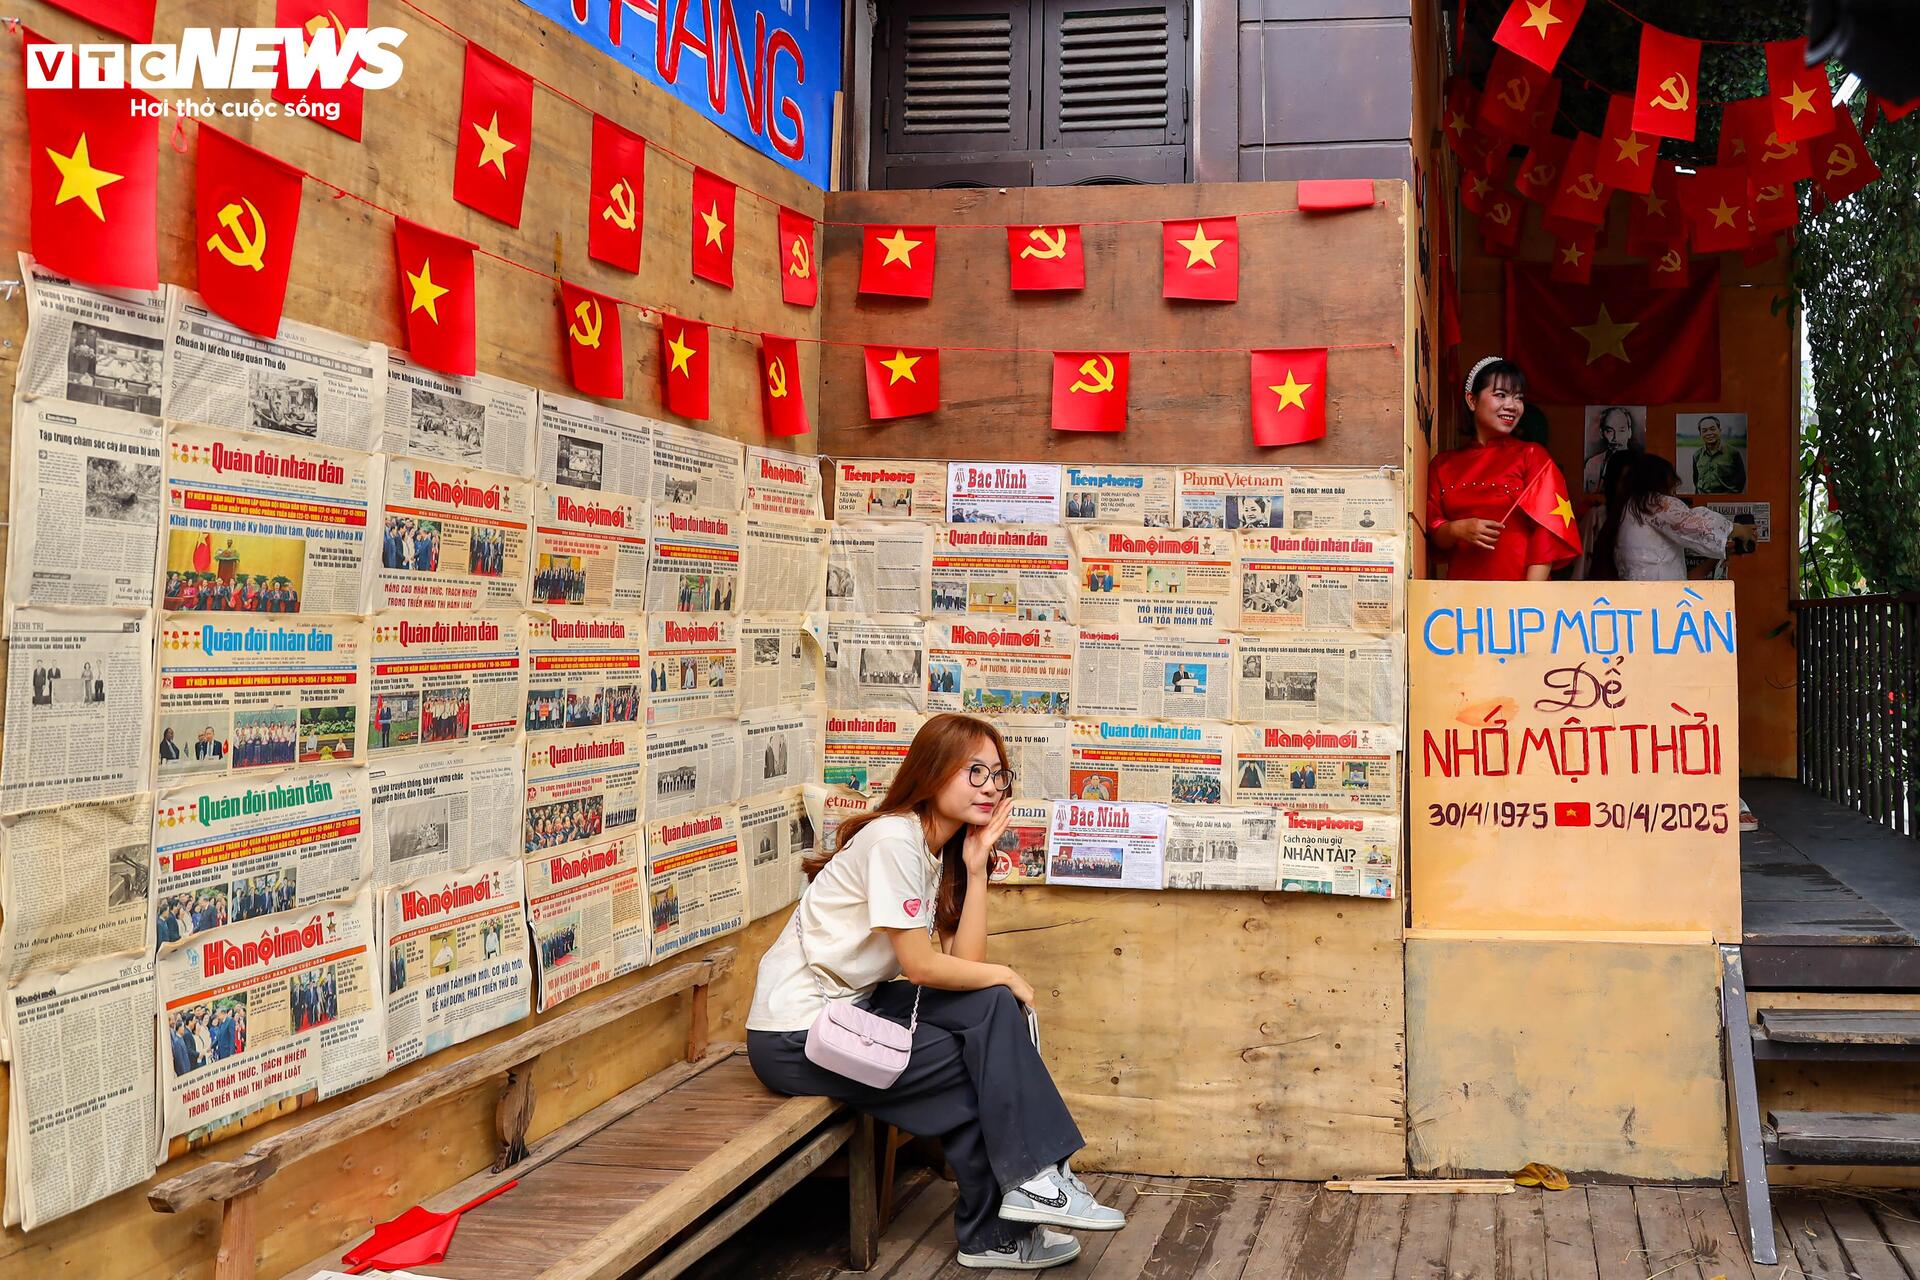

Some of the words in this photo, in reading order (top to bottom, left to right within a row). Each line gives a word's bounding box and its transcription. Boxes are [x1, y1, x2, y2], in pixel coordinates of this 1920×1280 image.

[212, 441, 251, 474] Quân
[254, 450, 279, 478] đội
[280, 454, 316, 482] nhân
[318, 459, 344, 485] dân
[968, 468, 992, 488] Bắc
[995, 469, 1027, 489] Ninh
[202, 624, 242, 657] Quân
[244, 626, 268, 655] đội
[269, 628, 306, 652] nhân
[307, 628, 333, 652] dân
[1423, 606, 1545, 664] CHỤP
[1551, 596, 1643, 664] MỘT
[1651, 587, 1735, 655] LẦN
[1534, 655, 1628, 713] Để
[1423, 704, 1510, 778] NHỚ
[1516, 716, 1617, 783] MỘT
[1619, 702, 1721, 776] THỜI
[198, 794, 241, 827] Quân
[242, 788, 268, 817] đội
[268, 784, 306, 812] nhân
[306, 779, 333, 805] dân
[1069, 804, 1094, 827] Bắc
[1097, 806, 1130, 828] Ninh
[1428, 801, 1549, 833] 30/4/1975
[1594, 801, 1729, 835] 30/4/2025
[1283, 844, 1324, 861] NHÂN
[1326, 846, 1356, 863] TÀI?
[1284, 834, 1300, 844] Cách
